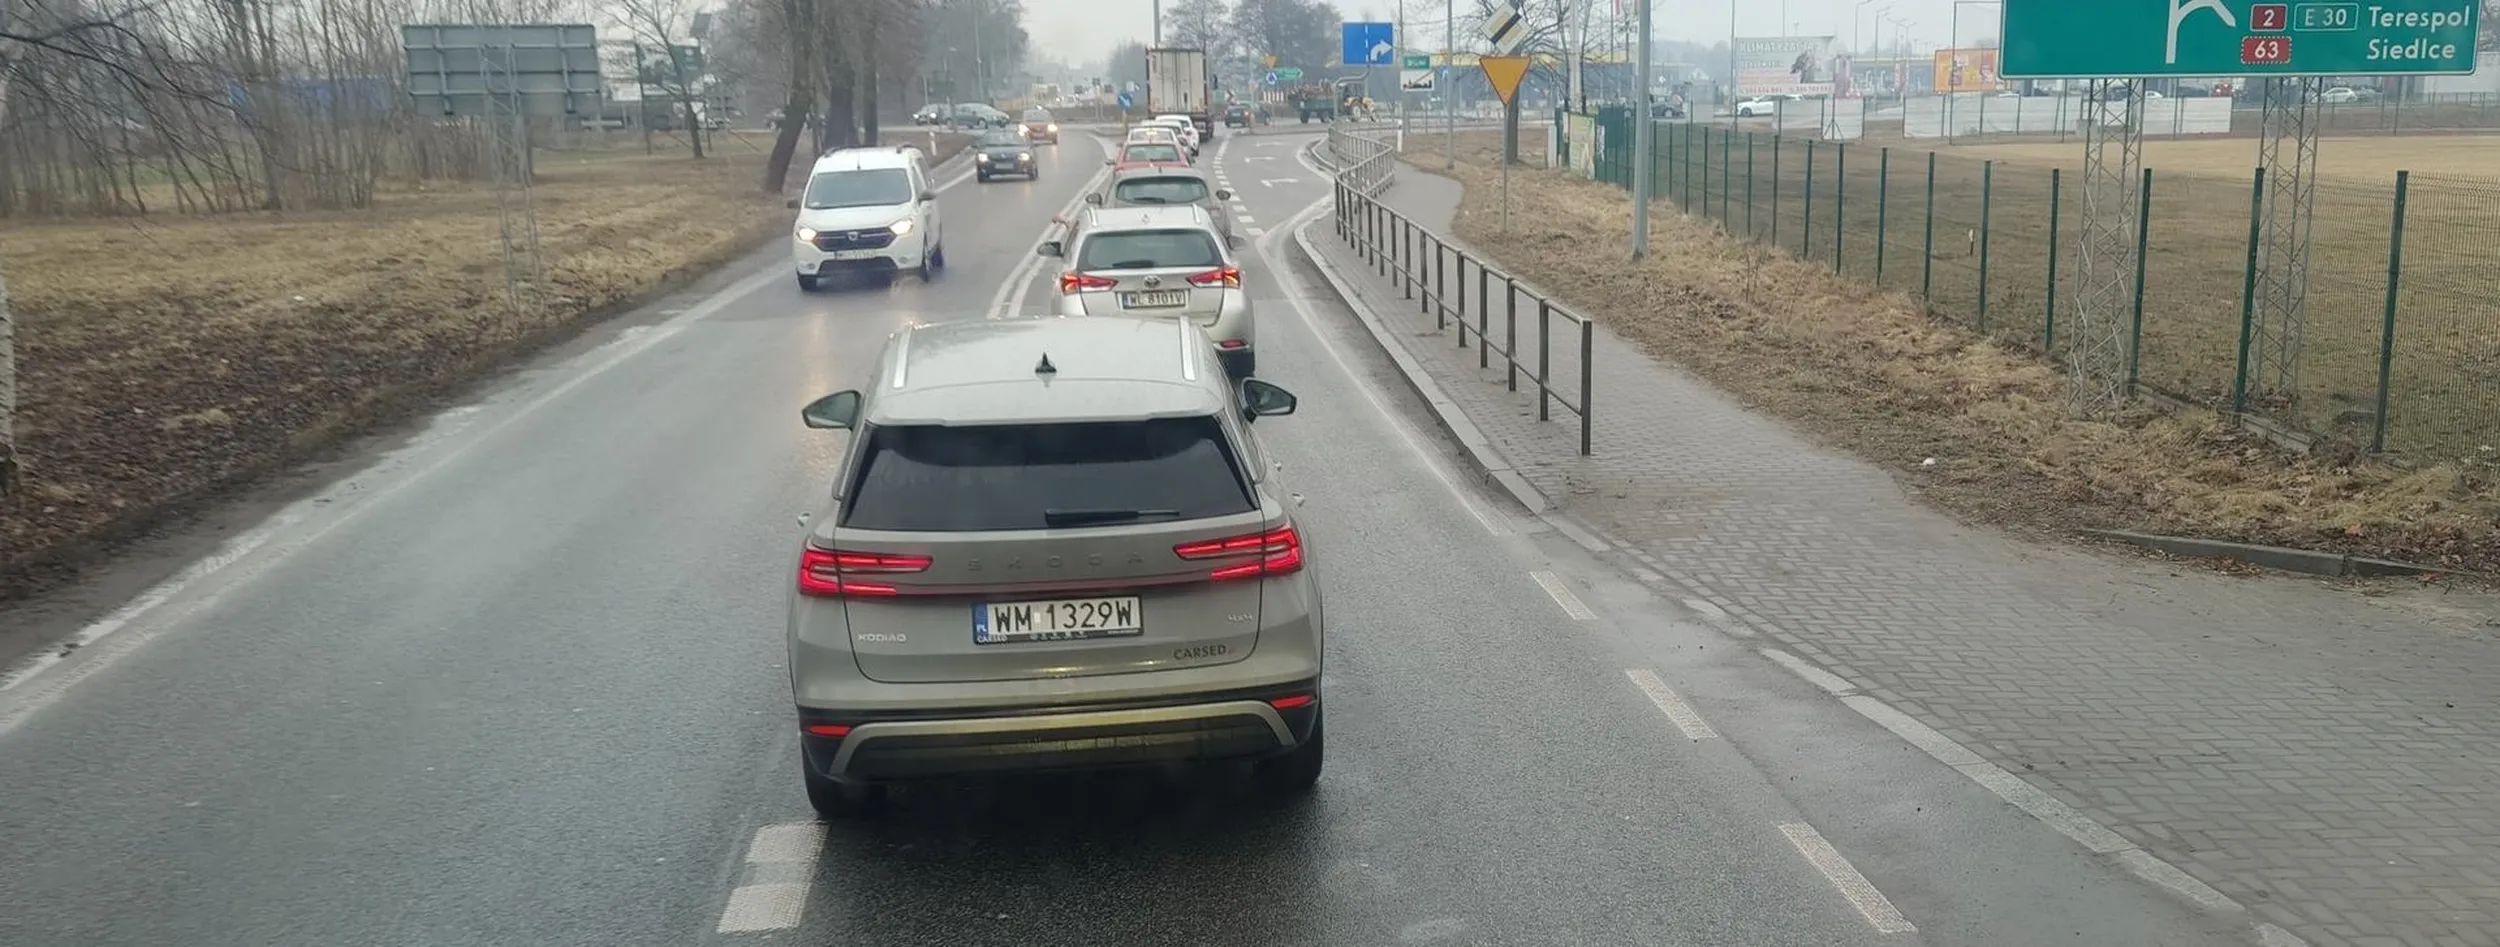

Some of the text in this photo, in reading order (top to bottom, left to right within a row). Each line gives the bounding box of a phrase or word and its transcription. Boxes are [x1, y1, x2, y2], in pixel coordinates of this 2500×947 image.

[2262, 9, 2274, 28] 2
[2304, 8, 2348, 26] E 30
[2368, 6, 2470, 33] Terespol
[2254, 41, 2280, 59] 63
[2366, 38, 2457, 60] Siedlce
[994, 599, 1132, 633] WM 1329W
